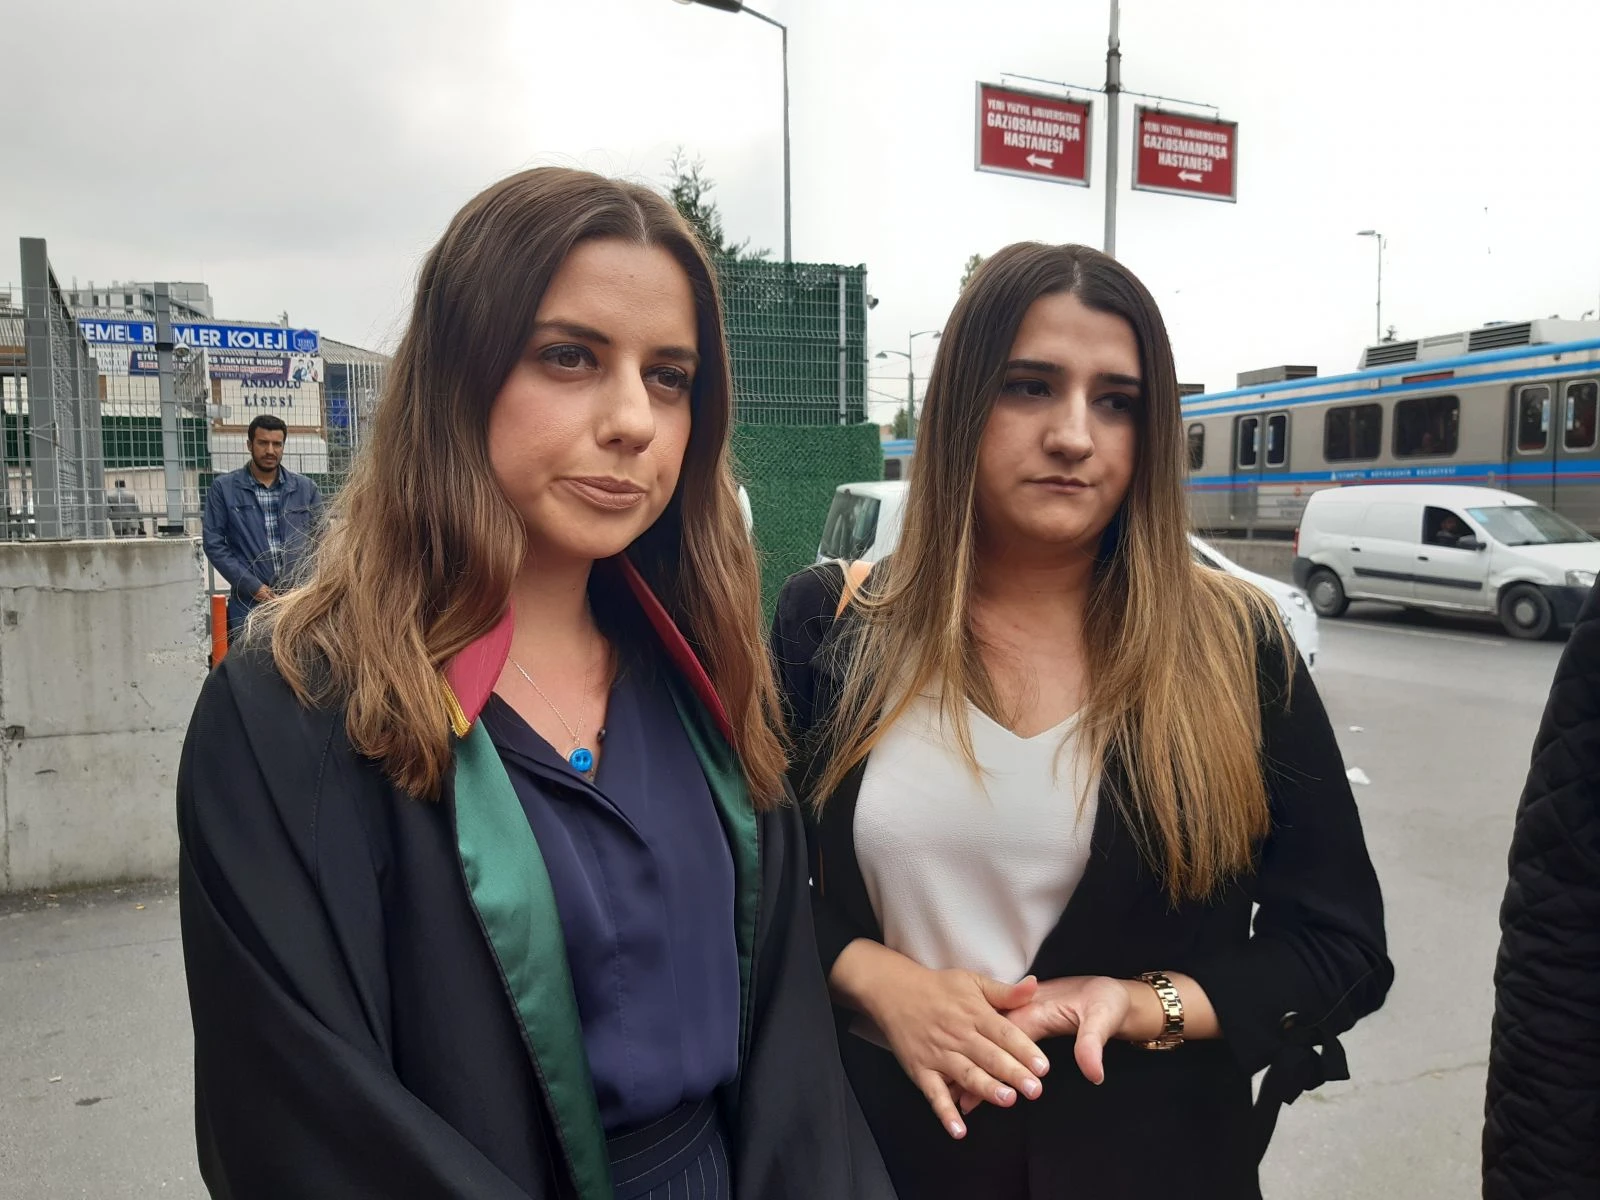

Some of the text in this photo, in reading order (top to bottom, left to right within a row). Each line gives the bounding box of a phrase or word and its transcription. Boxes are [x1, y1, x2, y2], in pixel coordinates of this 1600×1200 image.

[987, 112, 1080, 142] GAZİOSMANPAŞA
[1004, 131, 1064, 154] HASTANESİ
[1143, 134, 1228, 160] GAZİOSMANPAŞA
[1158, 151, 1213, 172] HASTANESİ
[227, 330, 288, 350] KOLEJİ
[220, 357, 255, 366] TAKVİYE
[256, 359, 283, 367] KURSU
